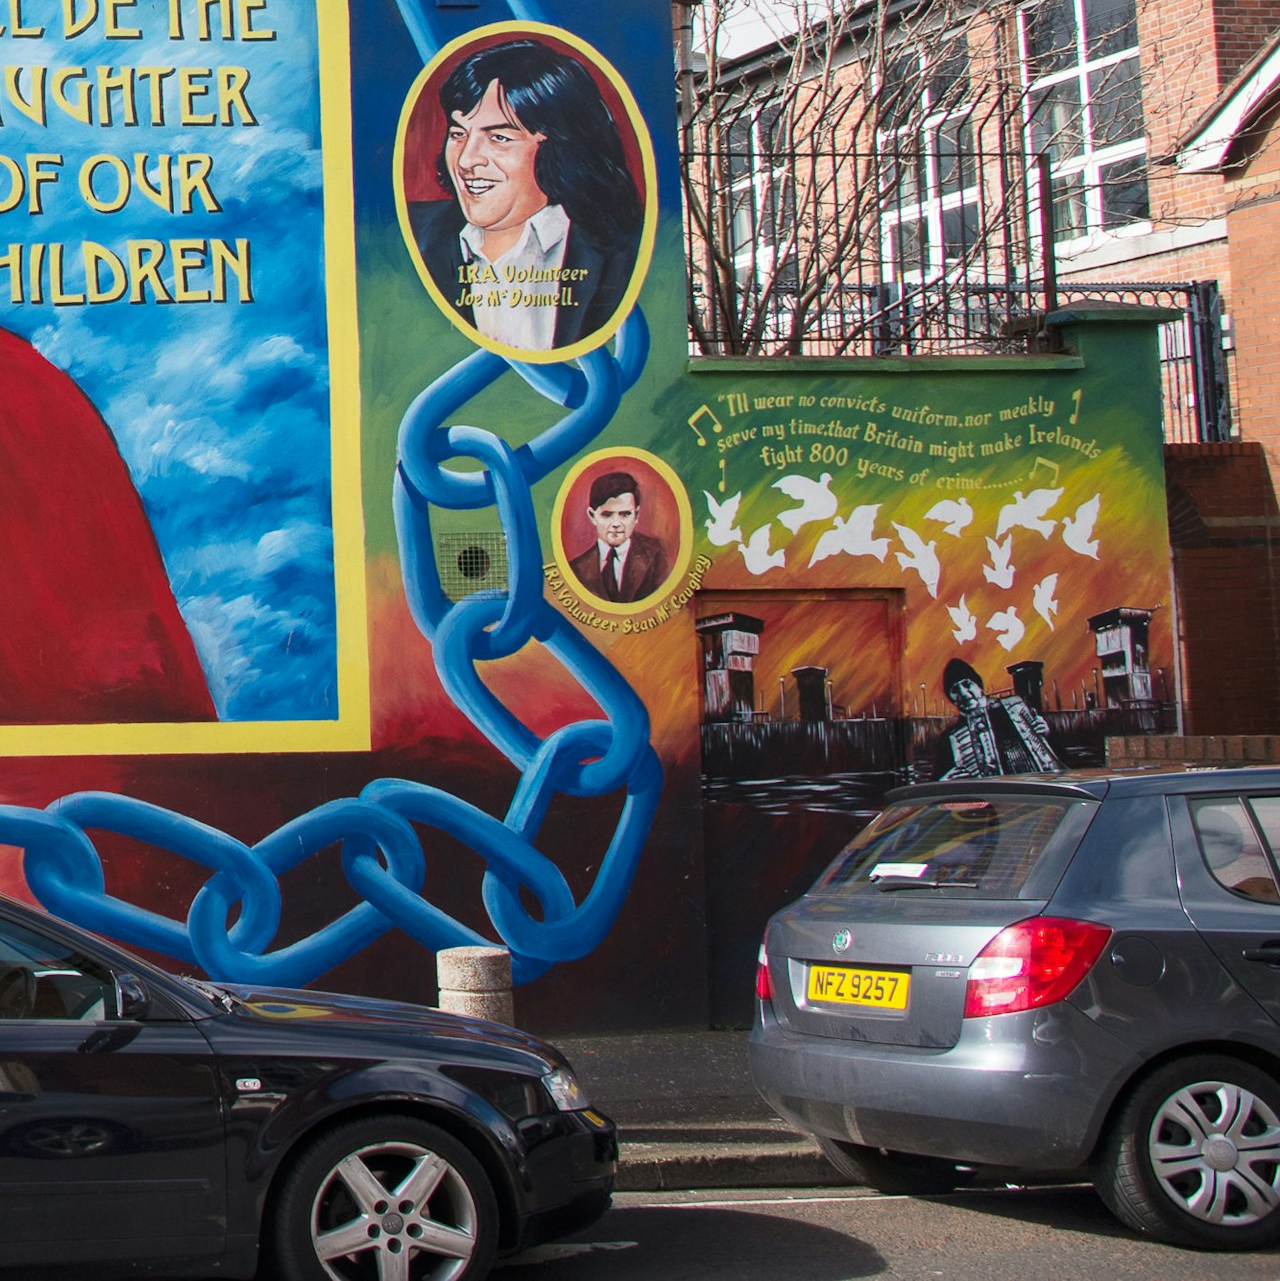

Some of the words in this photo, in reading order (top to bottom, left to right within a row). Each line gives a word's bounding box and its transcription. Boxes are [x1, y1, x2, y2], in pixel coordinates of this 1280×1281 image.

[79, 152, 223, 215] OUR
[503, 264, 589, 284] Volunteer
[455, 288, 483, 307] Joe
[754, 394, 795, 410] wear
[798, 395, 818, 408] no
[819, 394, 887, 414] convicts
[998, 395, 1056, 422] meakly
[716, 426, 758, 453] serve
[762, 423, 786, 441] my
[863, 421, 924, 454] Britain
[929, 440, 975, 464] might
[980, 432, 1023, 457] make
[1028, 423, 1102, 460] Irelands
[759, 444, 804, 470] fight
[808, 442, 849, 467] 800
[856, 457, 904, 481] years
[909, 468, 930, 487] of
[557, 588, 618, 633] Volunteer
[622, 617, 659, 636] Sean
[815, 970, 846, 997] NFZ
[850, 974, 899, 1002] 9257
